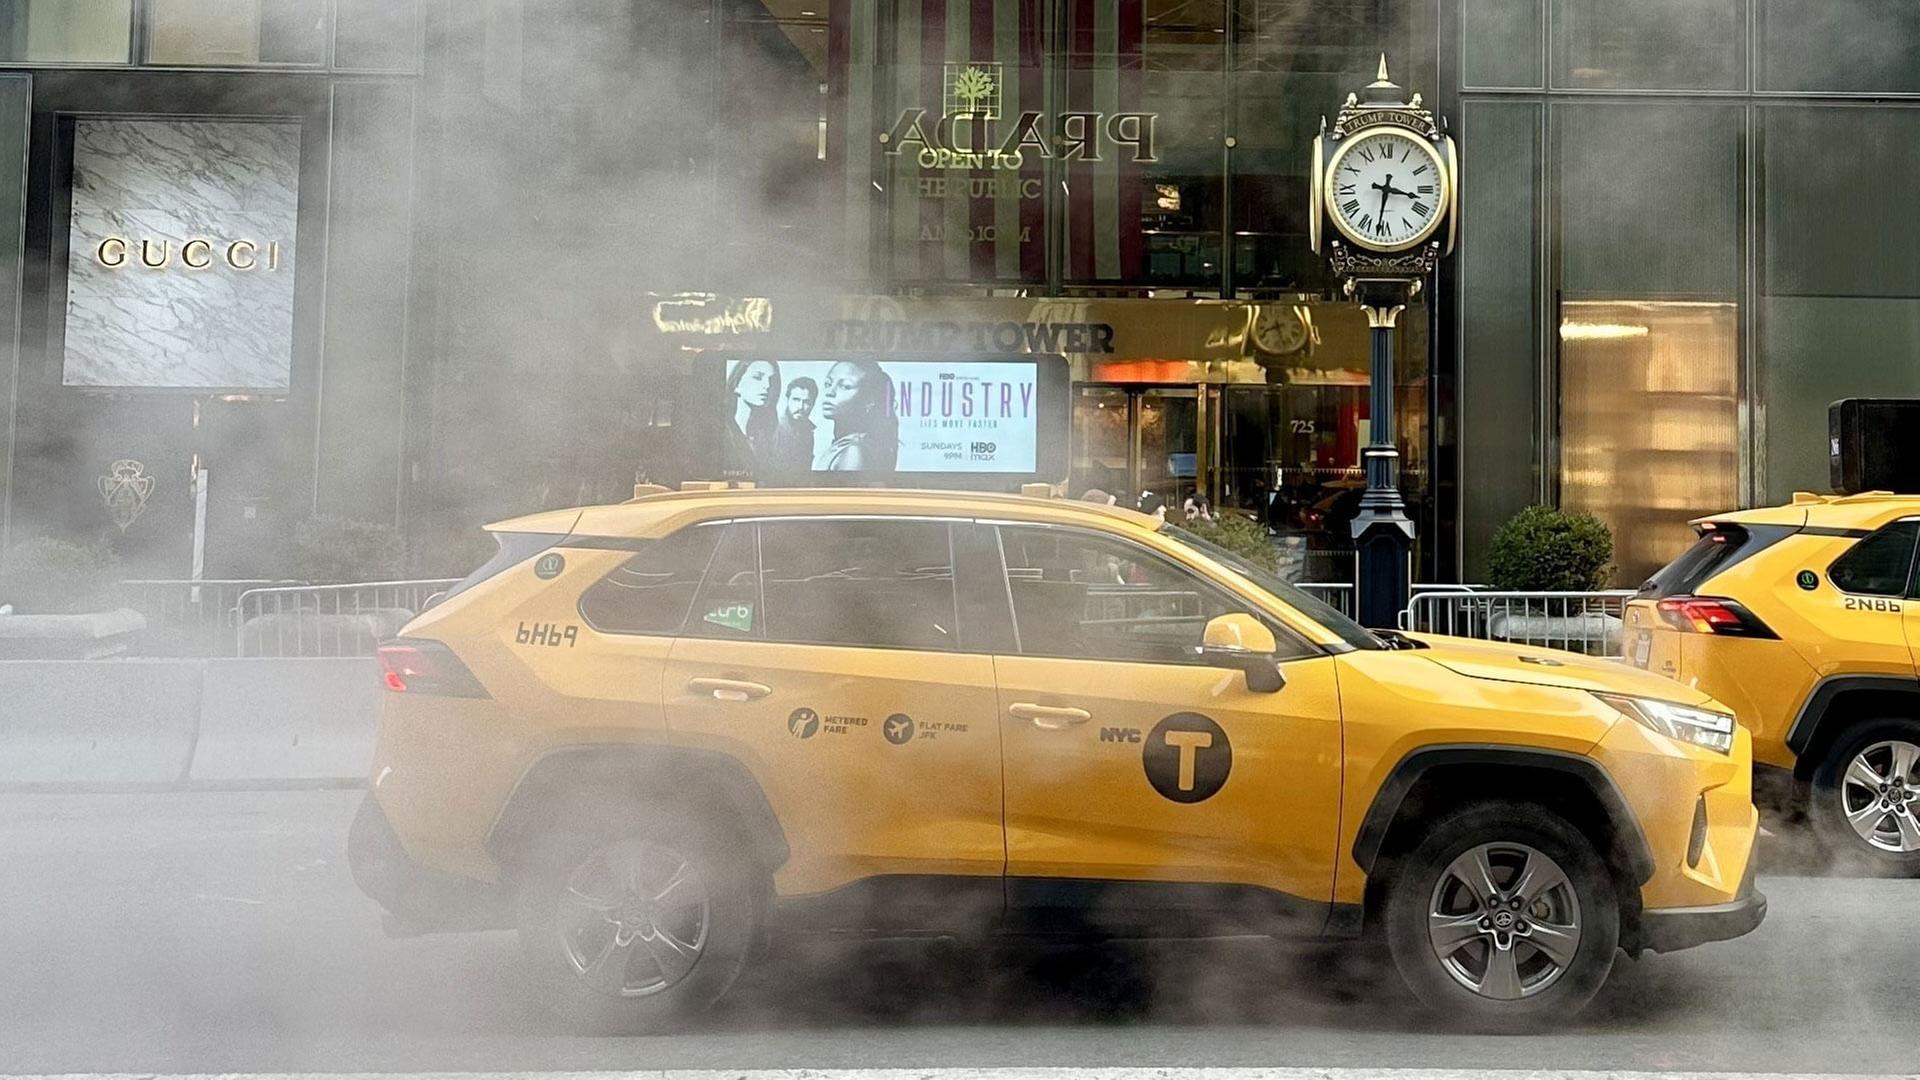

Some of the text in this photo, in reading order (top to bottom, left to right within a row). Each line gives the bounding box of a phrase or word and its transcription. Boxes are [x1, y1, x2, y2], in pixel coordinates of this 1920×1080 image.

[1346, 112, 1425, 131] TRUMP TOWER
[918, 149, 1023, 170] OPEN TO
[98, 237, 278, 270] GUCCI
[820, 320, 1115, 353] TRUMP TOWER
[884, 381, 1033, 418] INDUSTRY
[1290, 420, 1315, 433] 725
[921, 442, 963, 451] SUNDAYS
[970, 442, 997, 453] HBO
[824, 716, 868, 726] METERED
[919, 721, 968, 732] FLAT FARE
[824, 725, 847, 734] FARE
[1100, 727, 1212, 790] NYC T
